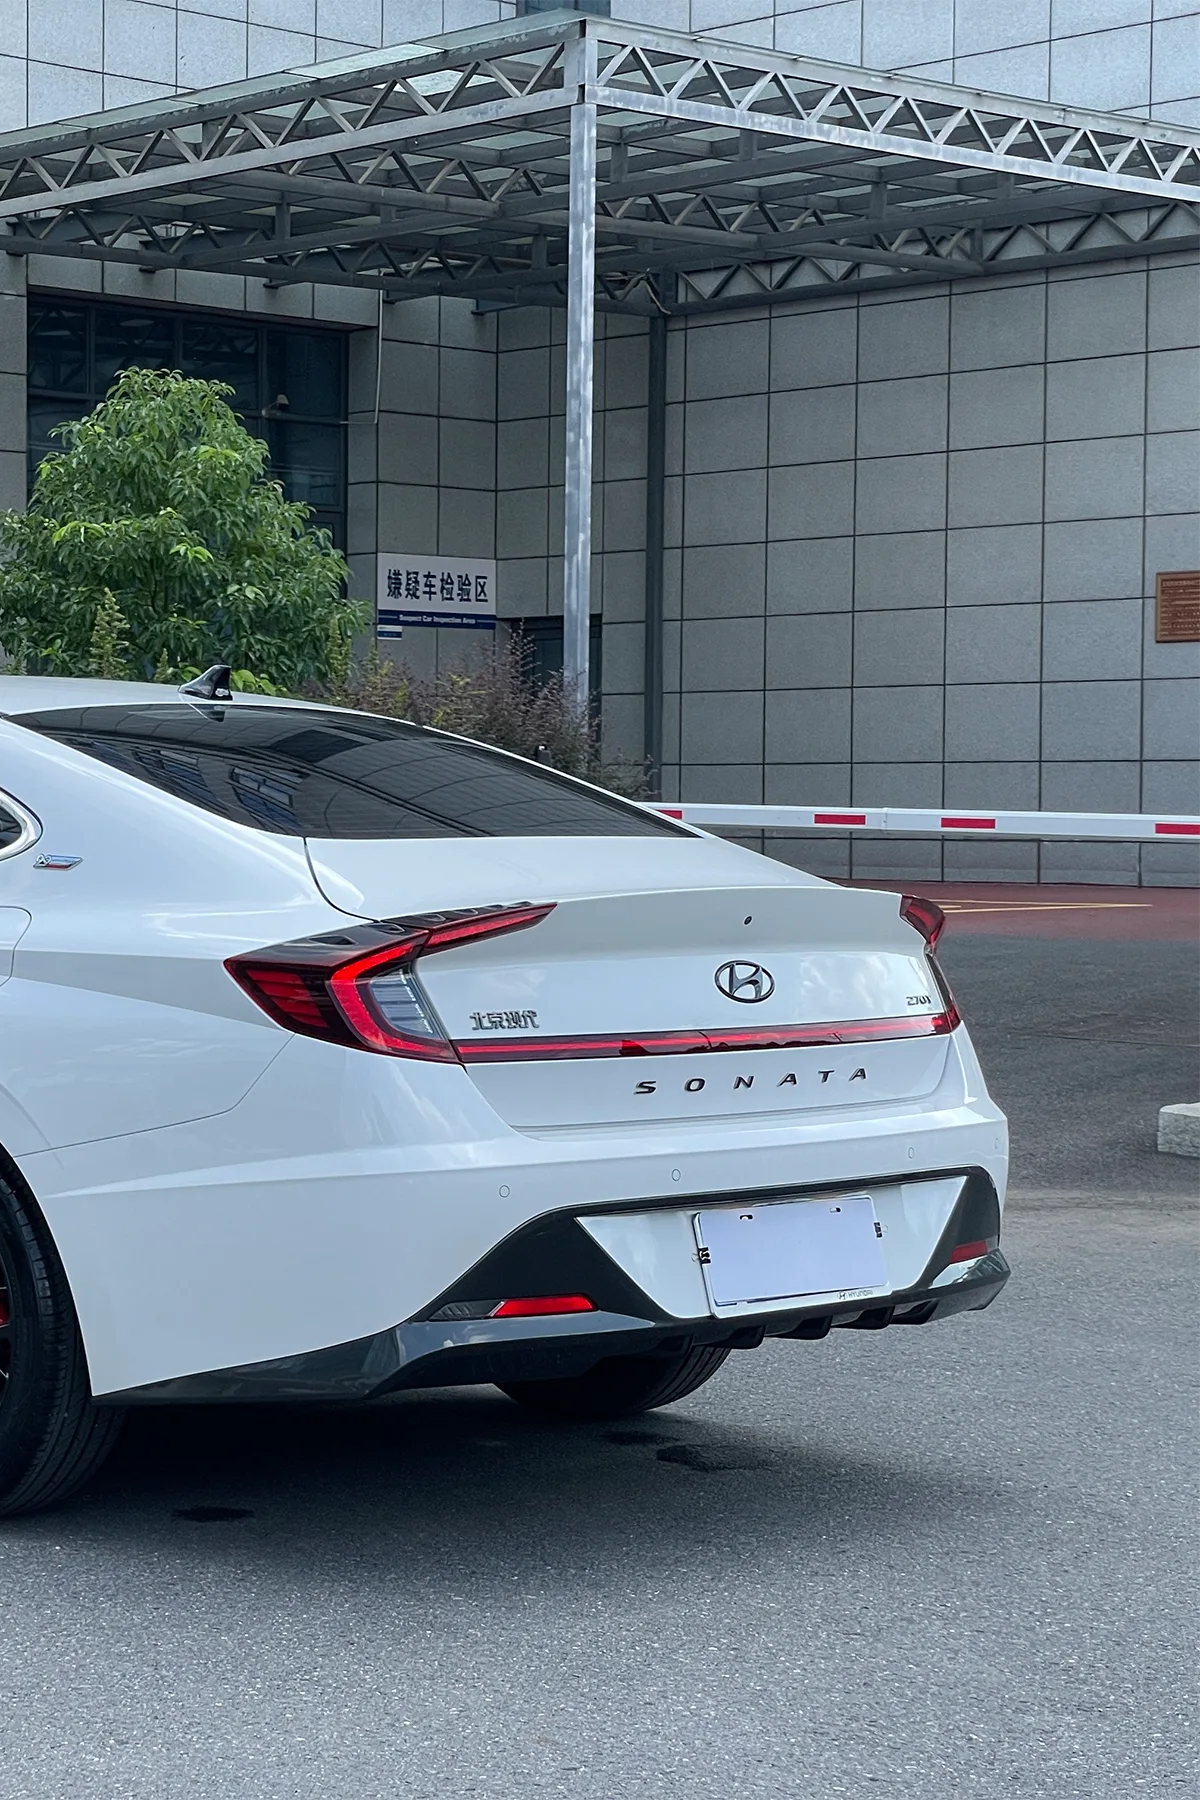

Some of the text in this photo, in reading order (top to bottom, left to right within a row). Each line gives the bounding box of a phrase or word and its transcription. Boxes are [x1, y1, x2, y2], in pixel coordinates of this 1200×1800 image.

[387, 568, 489, 603] 嫌疑车检验区
[433, 615, 461, 624] Inspection
[469, 1010, 540, 1031] 北京现代
[633, 1067, 867, 1095] SONATA
[848, 1289, 873, 1298] HYUNDAI
